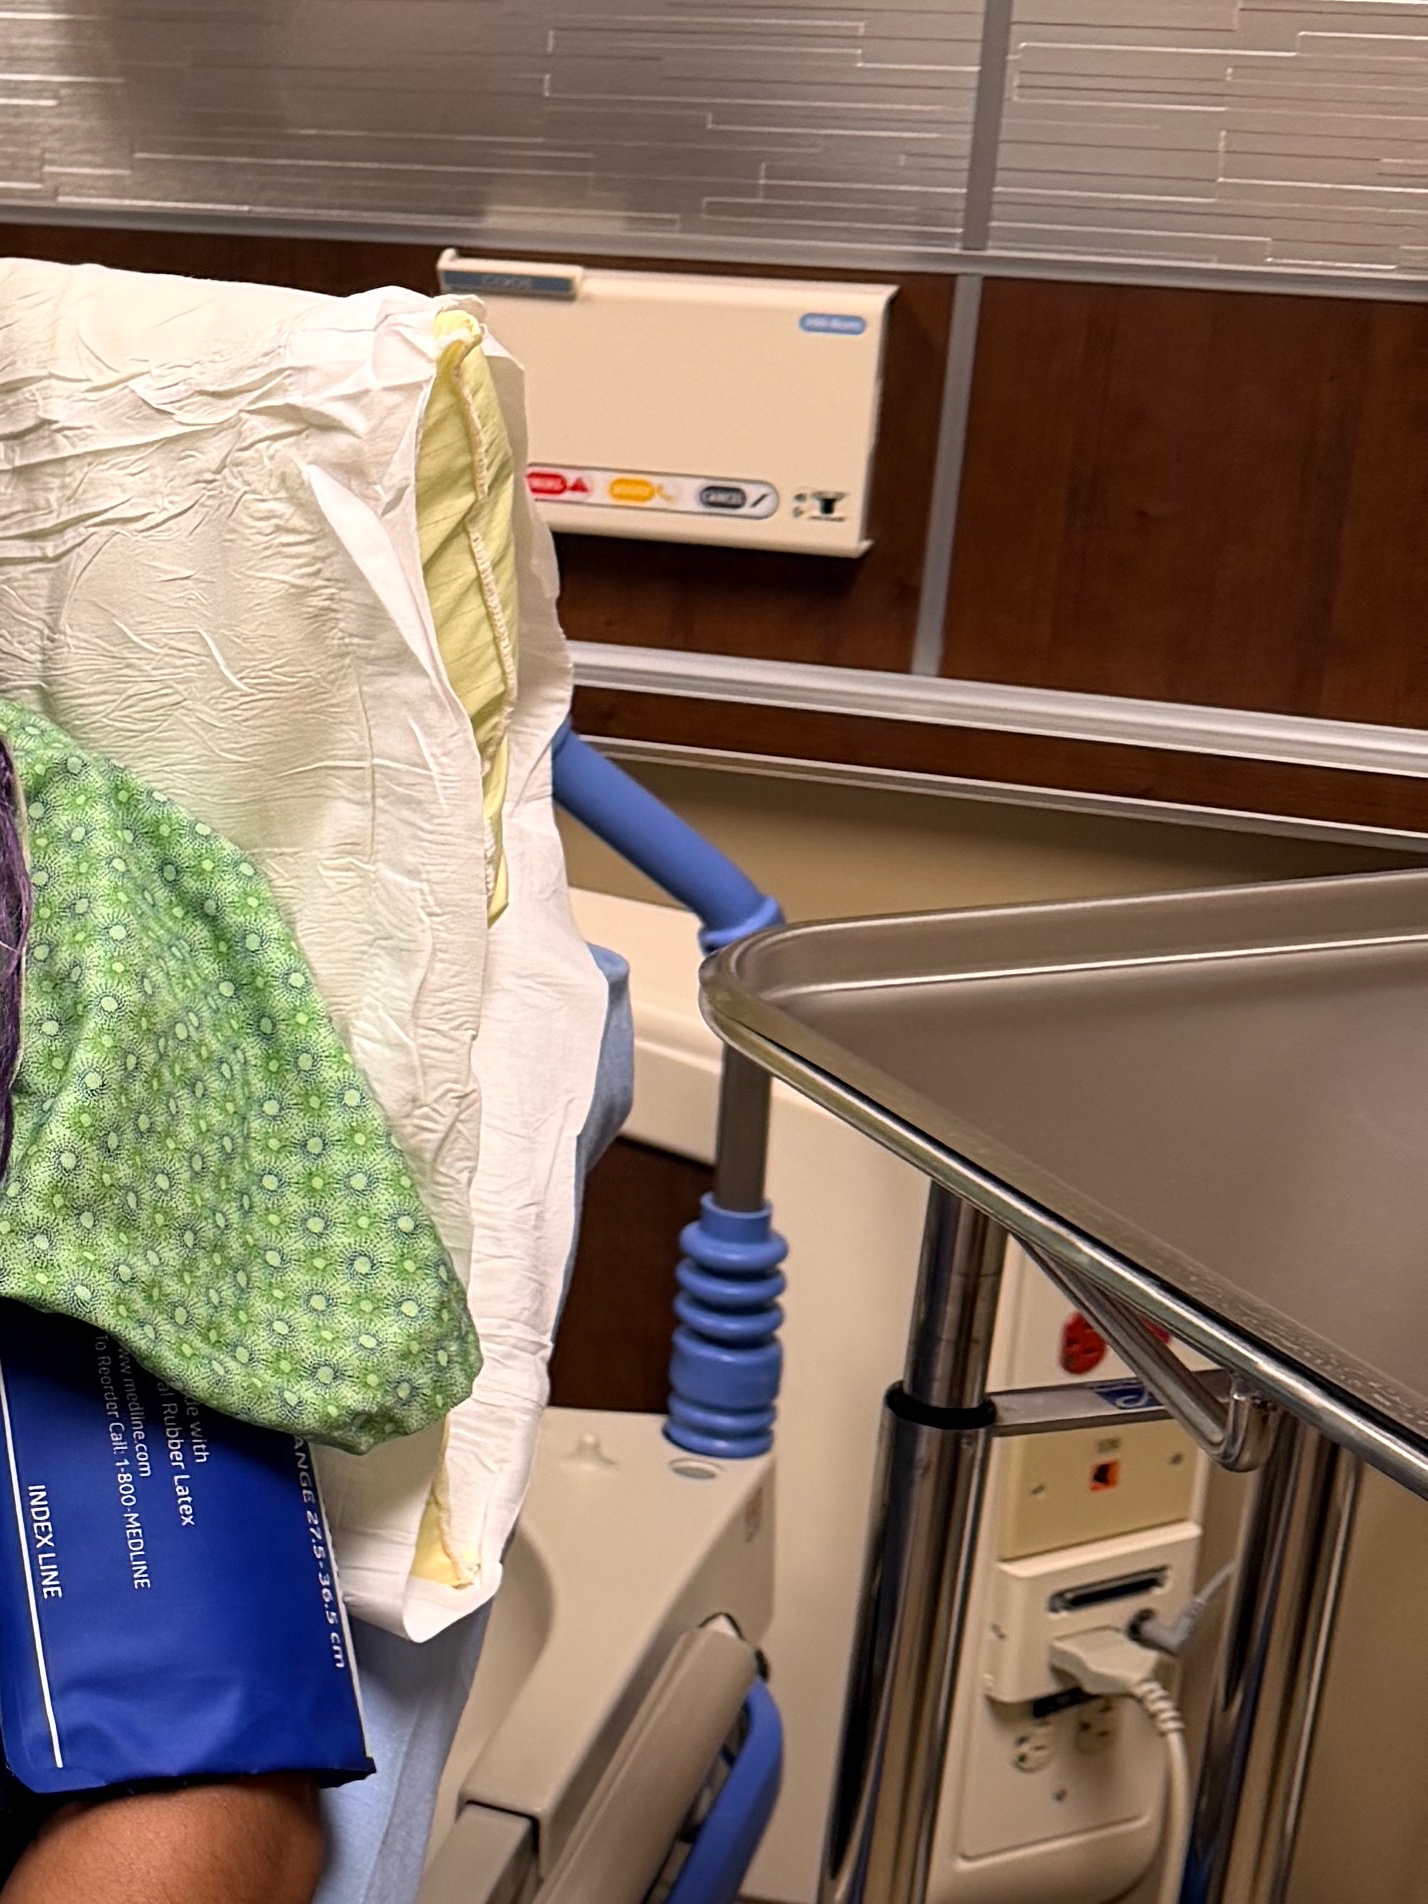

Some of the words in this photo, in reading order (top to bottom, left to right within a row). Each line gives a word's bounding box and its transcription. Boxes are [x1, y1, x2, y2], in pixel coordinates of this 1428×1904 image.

[162, 1402, 185, 1470] Rubber
[190, 1421, 209, 1463] with
[98, 1355, 120, 1419] Reorder
[115, 1458, 151, 1590] 1-800-MEDLINE
[173, 1475, 195, 1527] Latex
[28, 1484, 55, 1549] INDEX
[37, 1552, 62, 1600] LINE
[295, 1436, 316, 1504] ANGE
[306, 1510, 338, 1626] 27.5-36.5
[330, 1632, 345, 1669] cm
